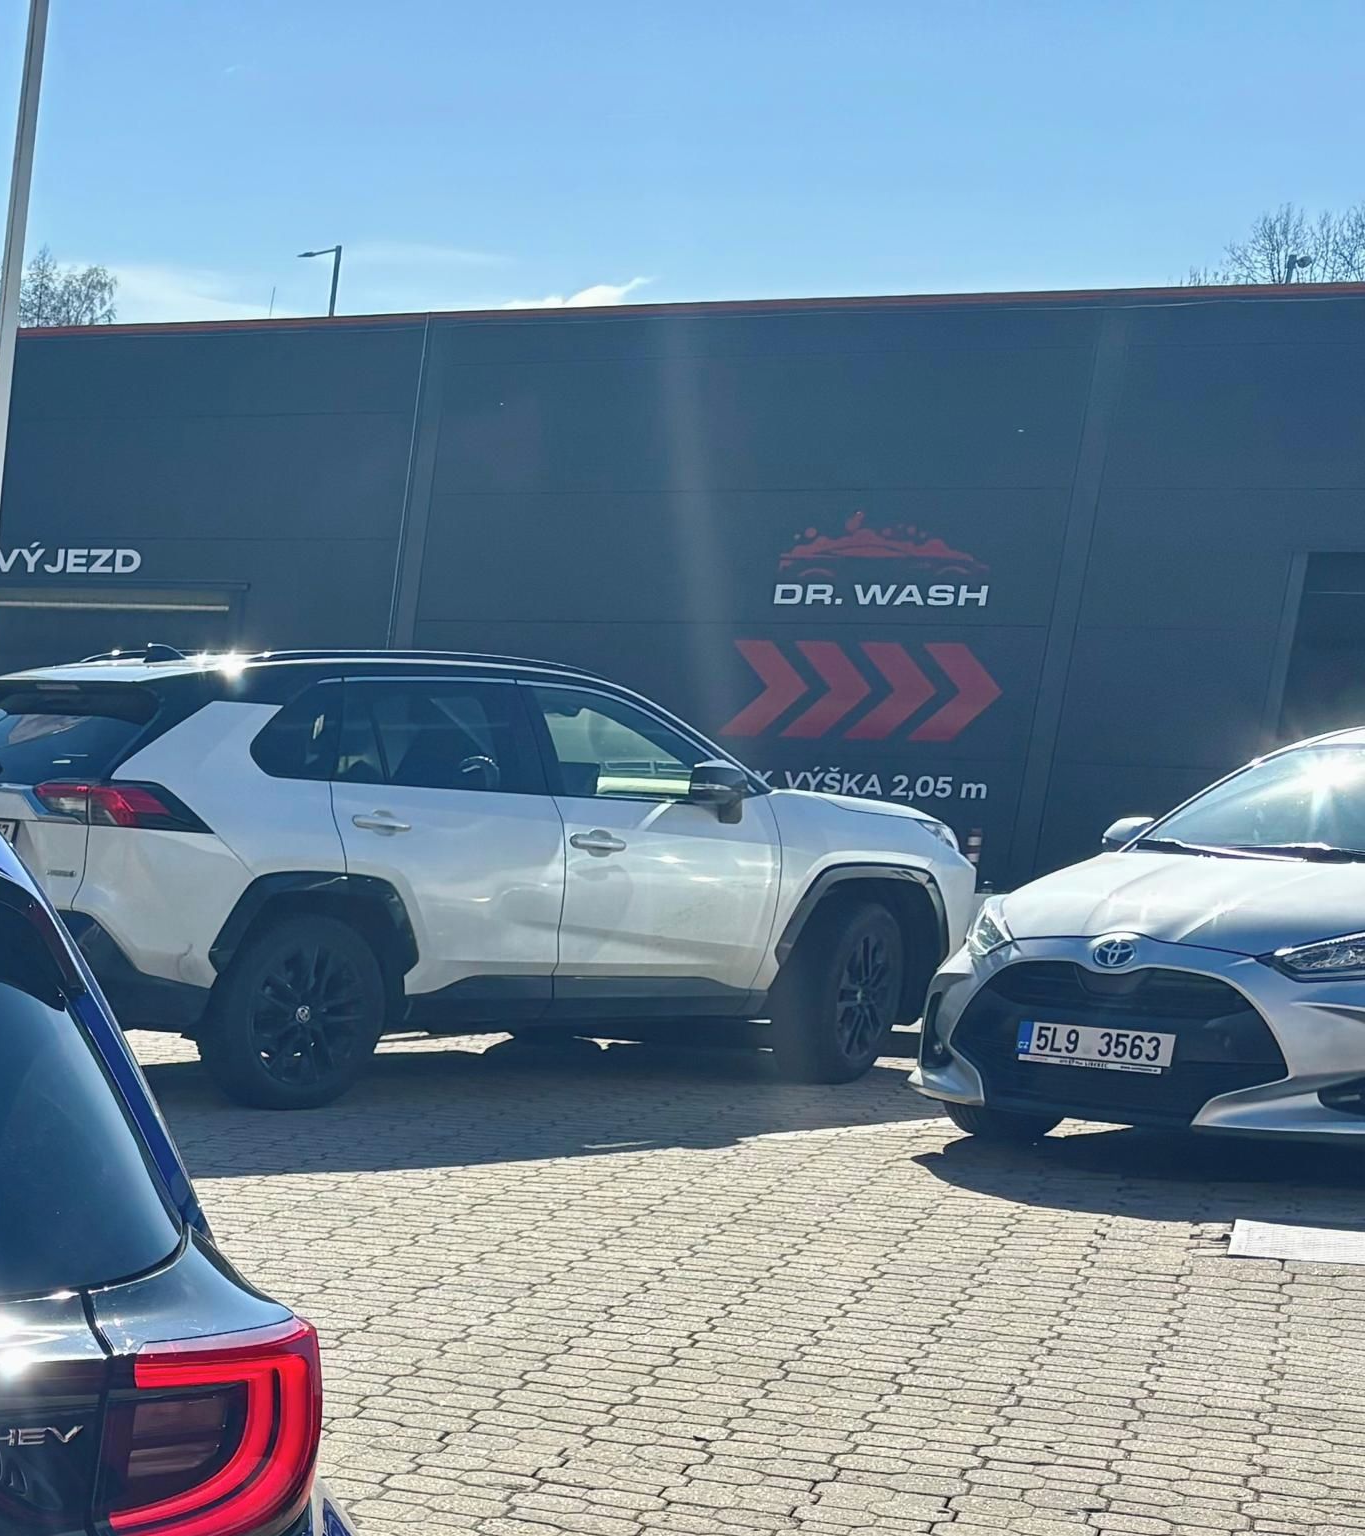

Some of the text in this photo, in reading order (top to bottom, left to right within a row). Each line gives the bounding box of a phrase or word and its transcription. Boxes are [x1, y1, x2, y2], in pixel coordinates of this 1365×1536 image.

[773, 584, 990, 607] DR. WASH
[784, 766, 882, 796] VÝŠKA
[890, 775, 953, 801] 2,05
[960, 783, 988, 799] m
[1036, 1026, 1161, 1062] 5L9 3563
